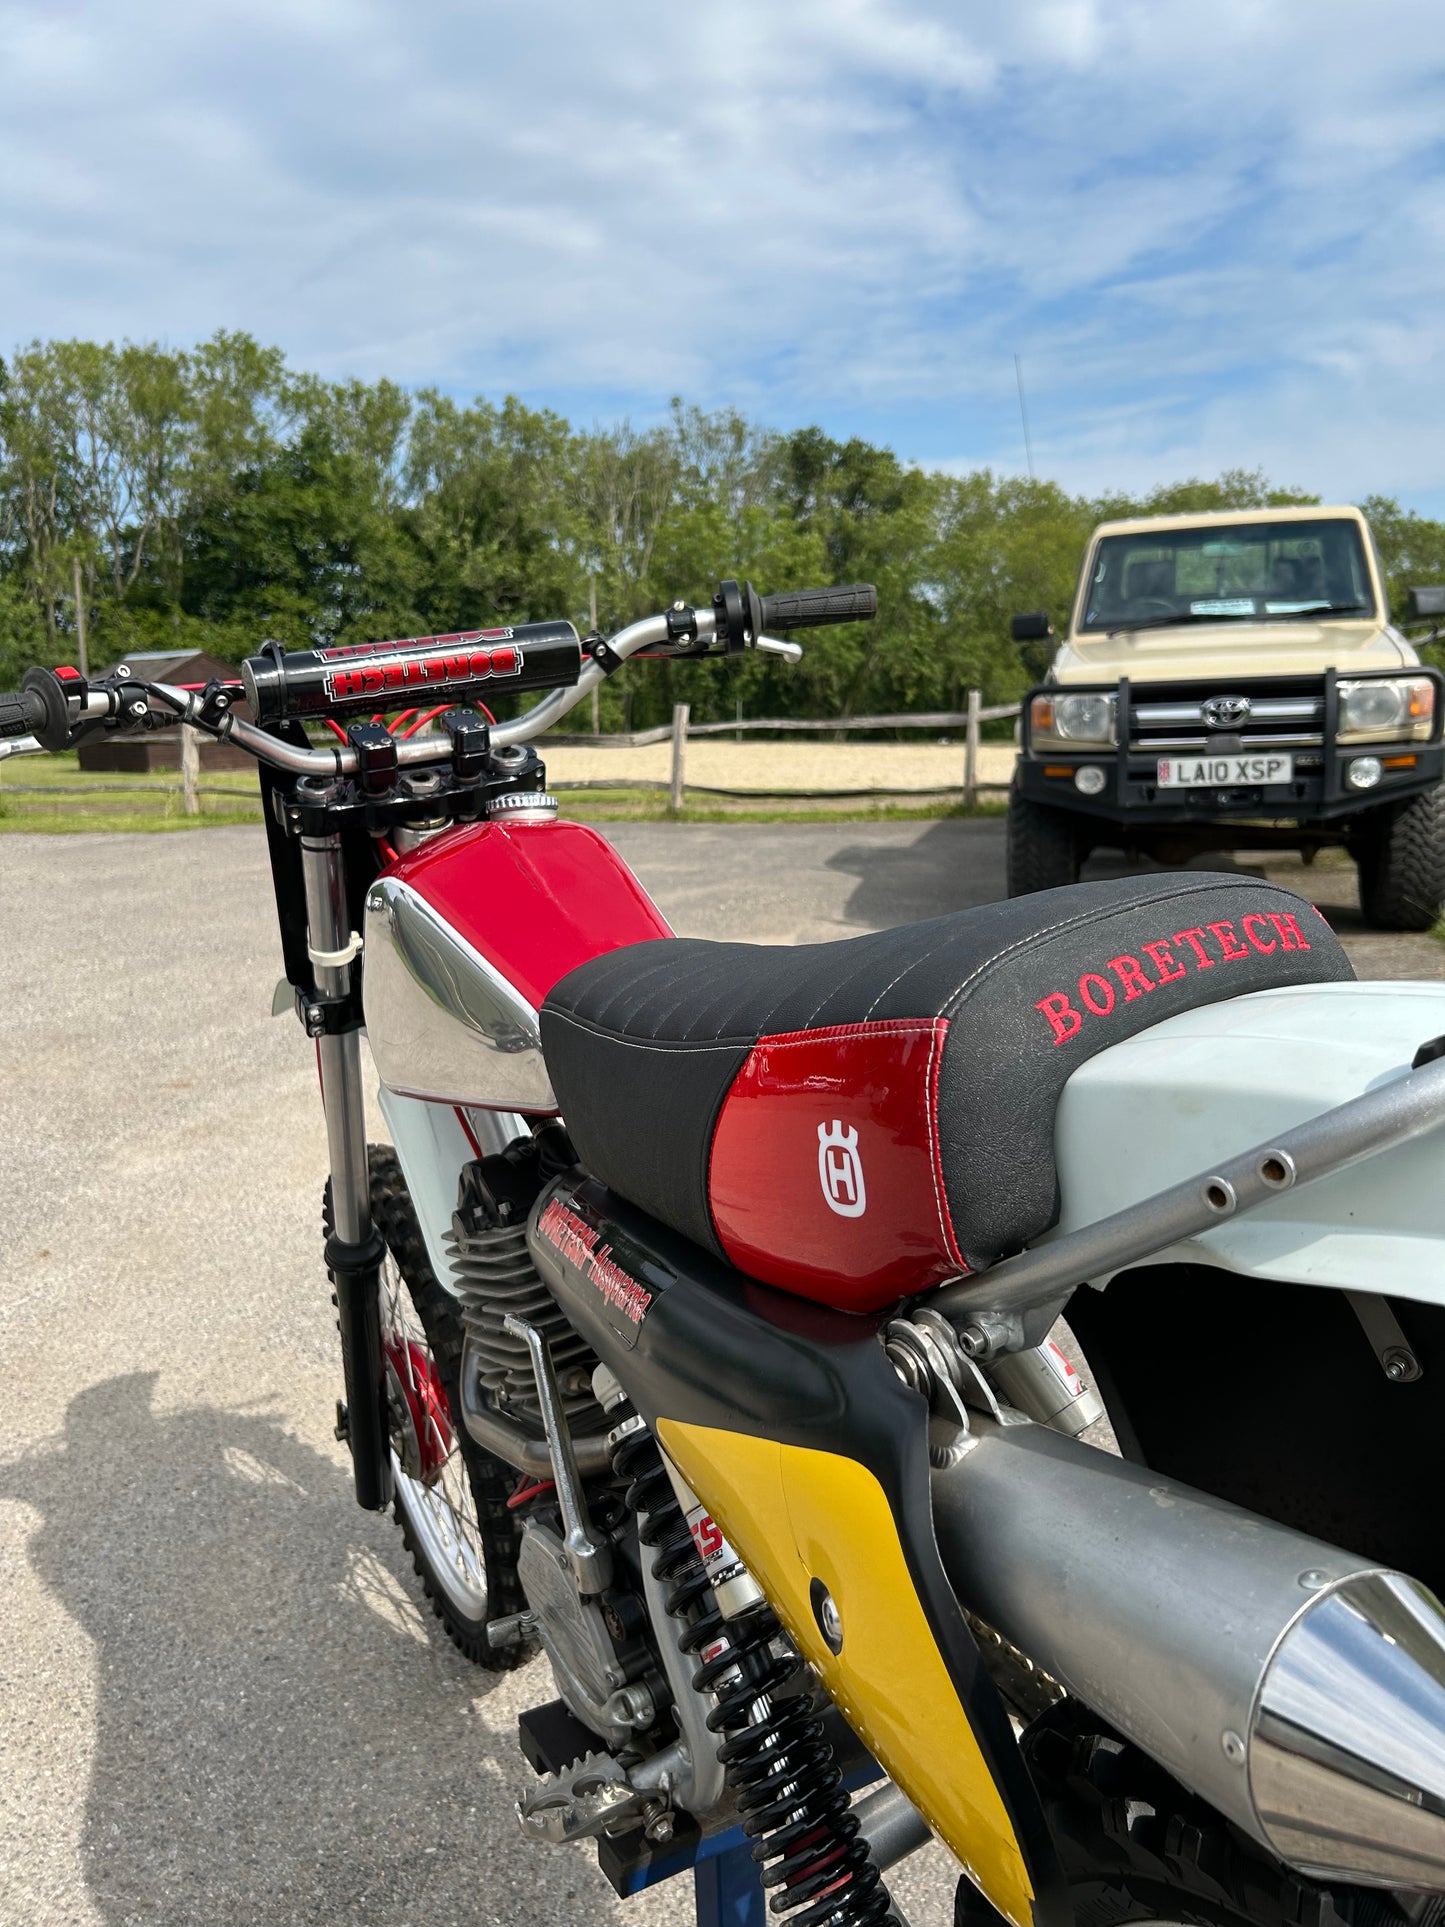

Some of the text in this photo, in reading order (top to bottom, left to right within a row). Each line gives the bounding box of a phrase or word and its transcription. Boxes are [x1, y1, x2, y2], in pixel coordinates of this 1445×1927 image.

[326, 646, 522, 699] BORETECH
[1236, 759, 1281, 780] XSP
[1034, 912, 1311, 1047] BORETECH
